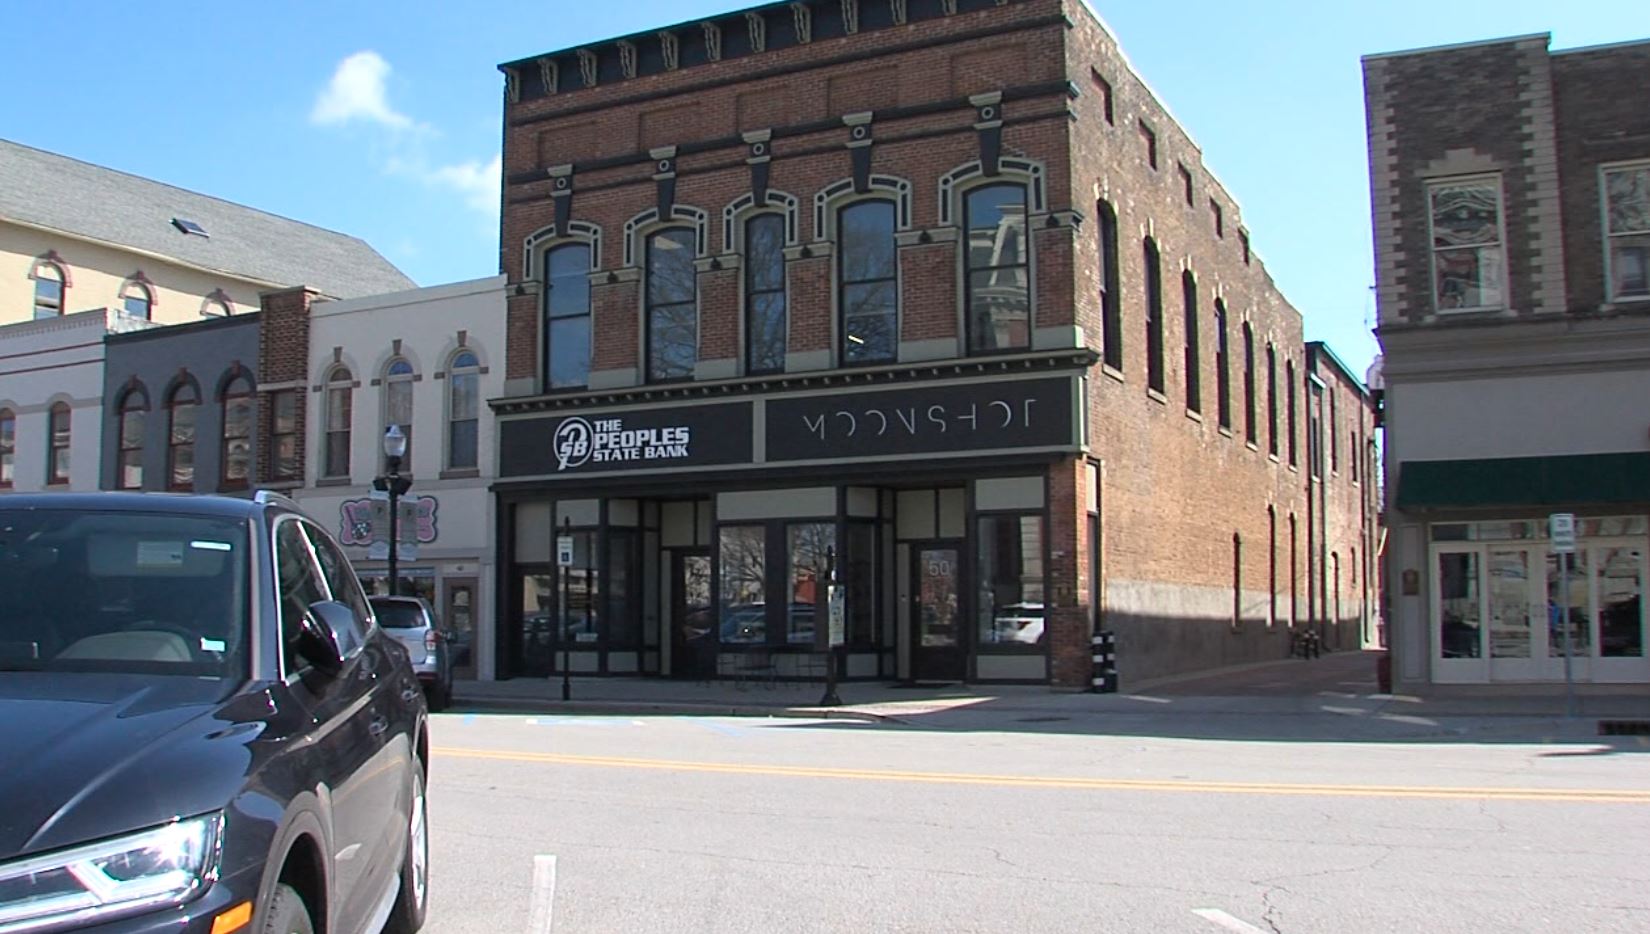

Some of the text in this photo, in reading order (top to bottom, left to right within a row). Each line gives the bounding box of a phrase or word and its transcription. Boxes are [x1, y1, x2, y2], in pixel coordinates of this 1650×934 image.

[594, 419, 622, 431] THE
[594, 427, 689, 449] PEOPLES
[593, 444, 689, 462] STATE BANK
[928, 560, 950, 576] 50
